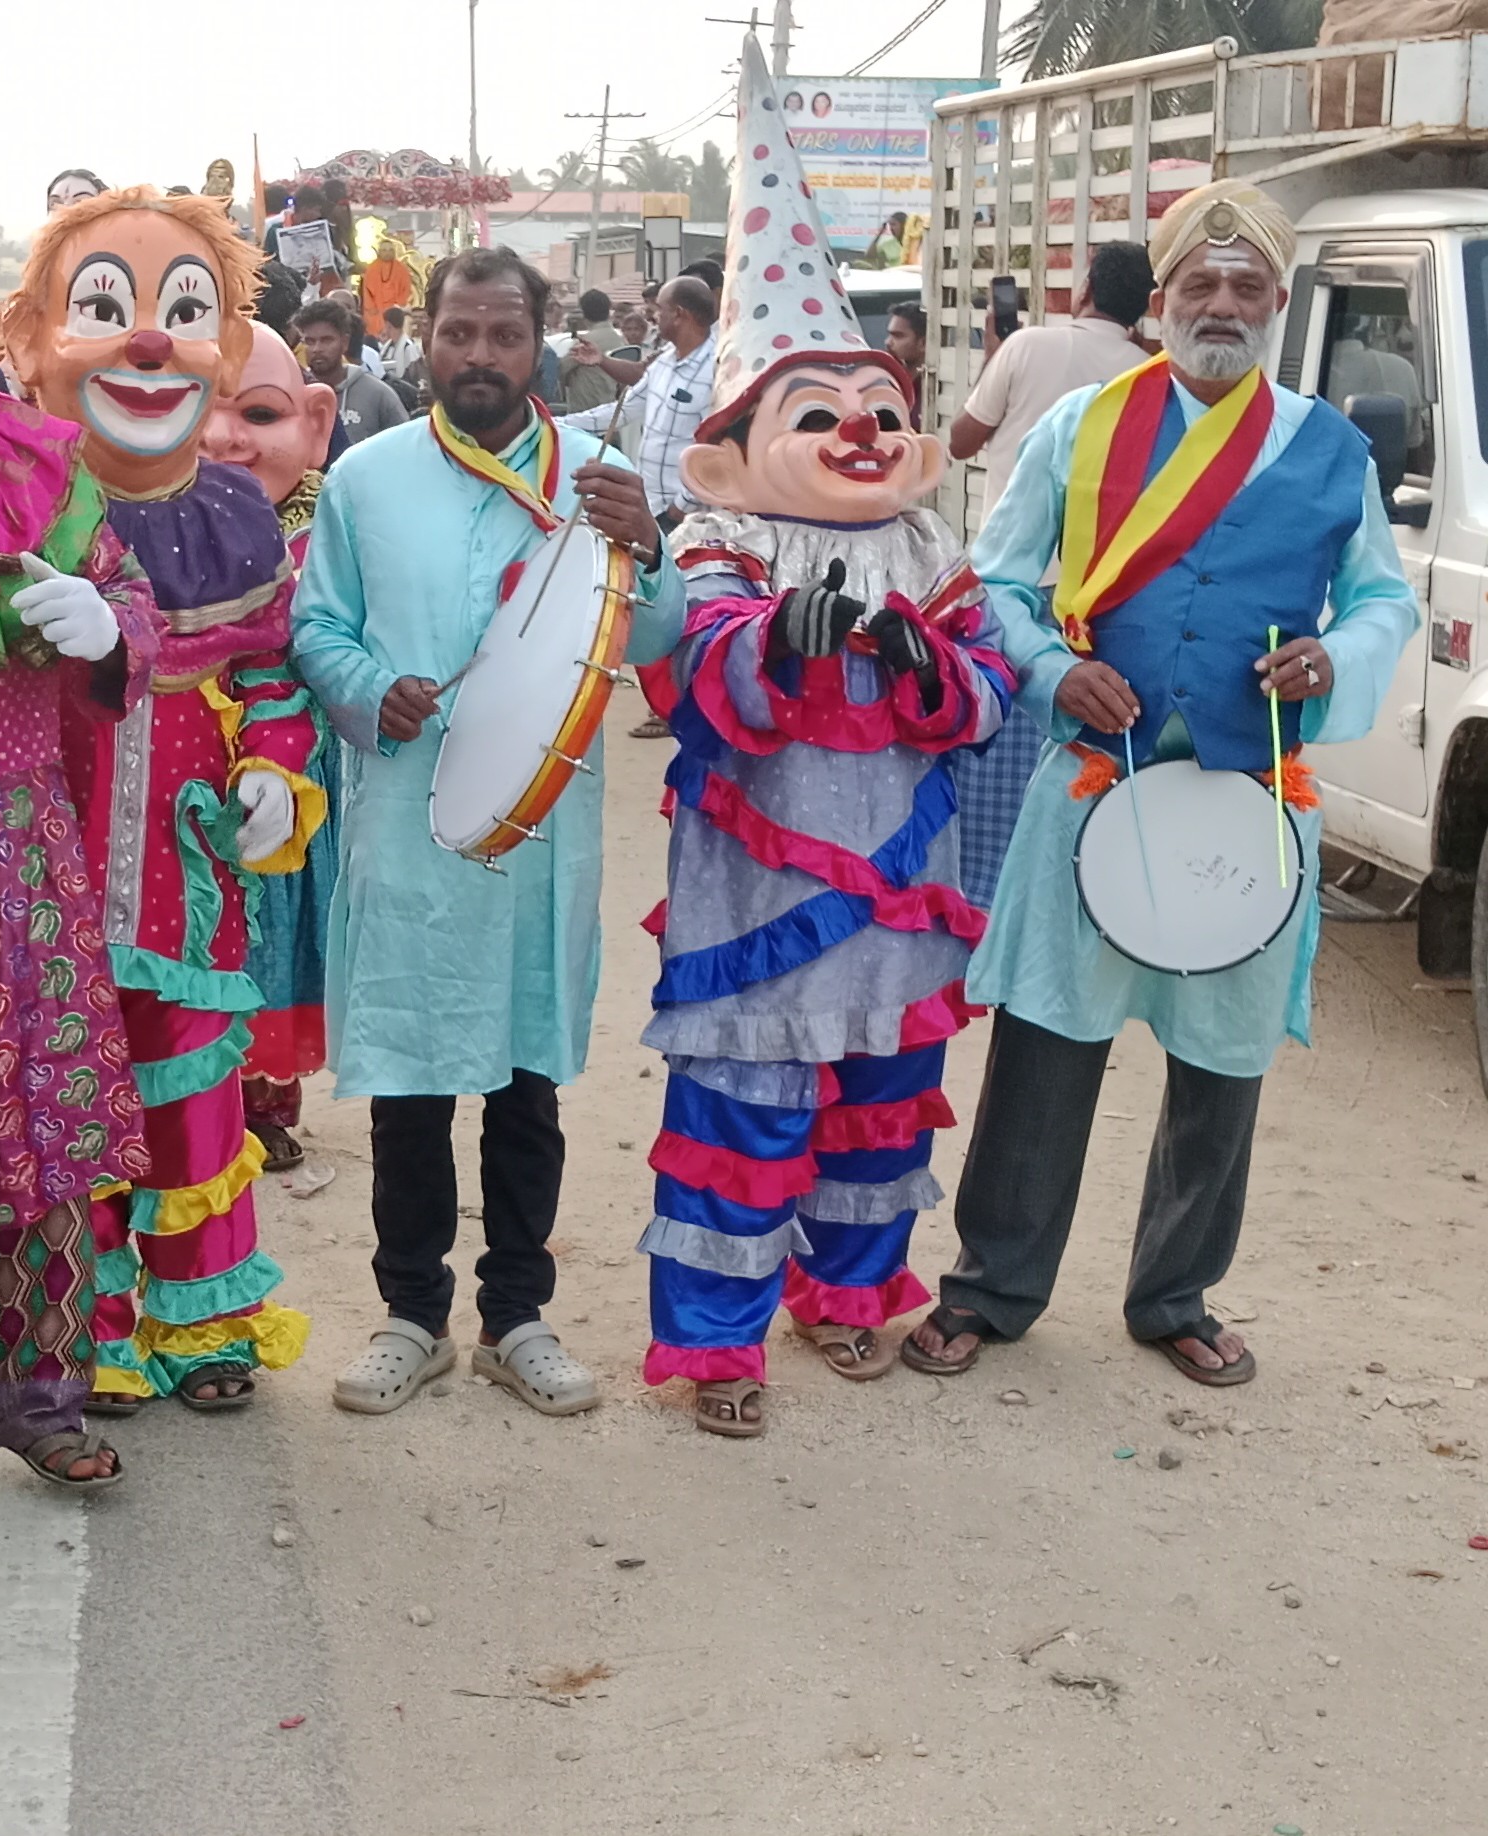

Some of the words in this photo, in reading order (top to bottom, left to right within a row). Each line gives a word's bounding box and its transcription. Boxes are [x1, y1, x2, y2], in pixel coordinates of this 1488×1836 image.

[792, 131, 839, 151] TARS
[847, 132, 880, 151] ON
[887, 134, 920, 153] THE
